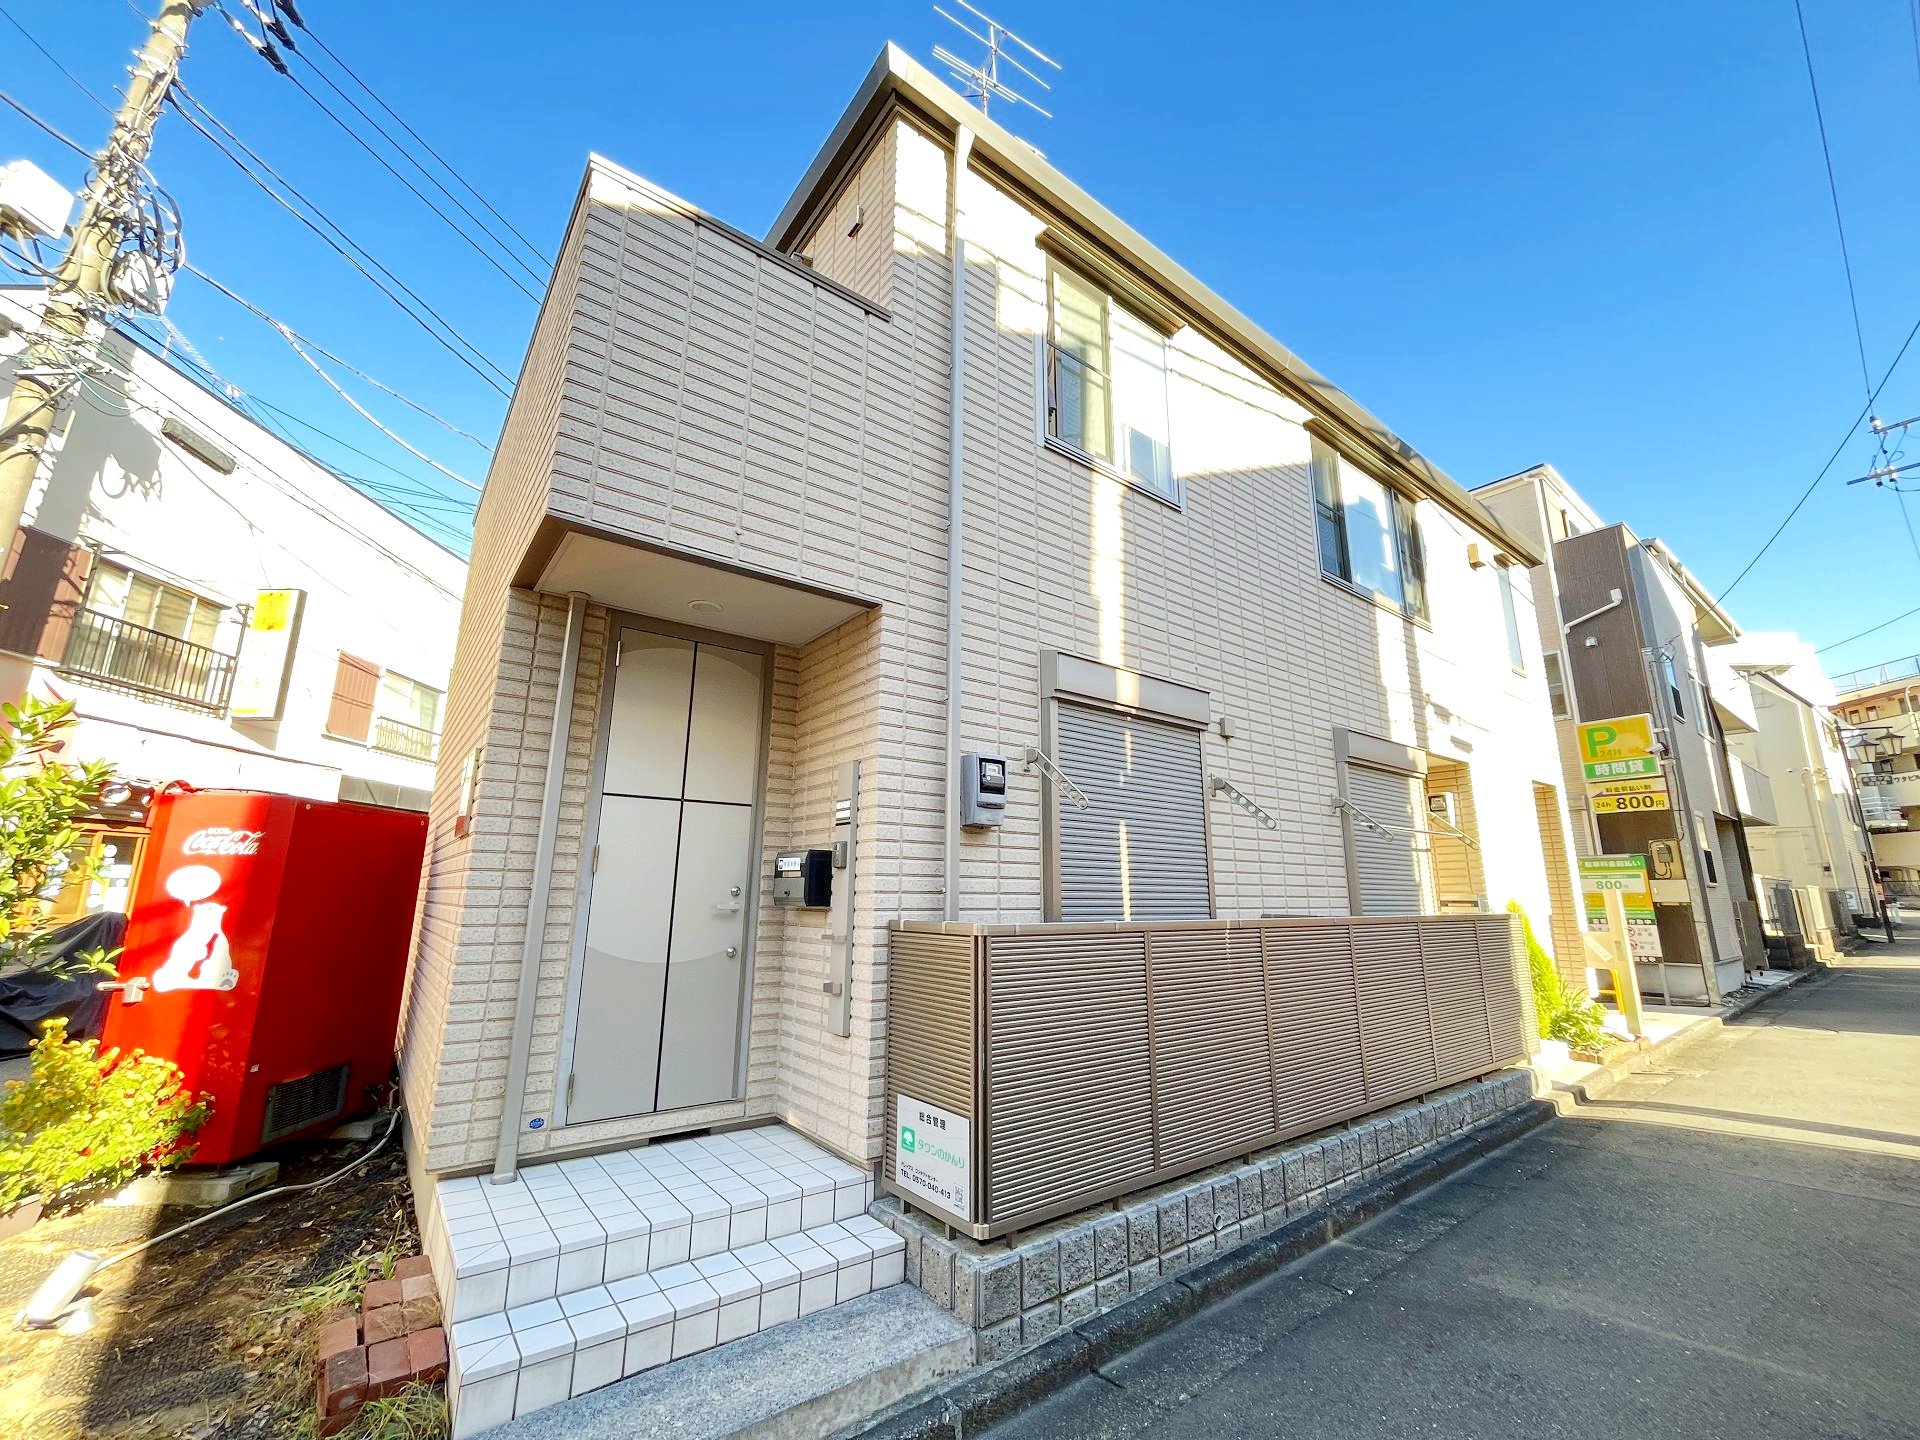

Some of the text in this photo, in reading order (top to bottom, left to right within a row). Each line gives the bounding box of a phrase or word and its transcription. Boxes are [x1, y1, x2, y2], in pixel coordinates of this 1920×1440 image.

[1585, 725, 1617, 758] P
[1599, 748, 1622, 758] 24H
[1594, 759, 1645, 776] 時間貸
[1595, 795, 1665, 810] 24h 800円
[919, 1111, 946, 1130] 総合管理
[917, 1139, 965, 1169] タウンのかんり
[912, 1174, 951, 1200] 0570-040-413
